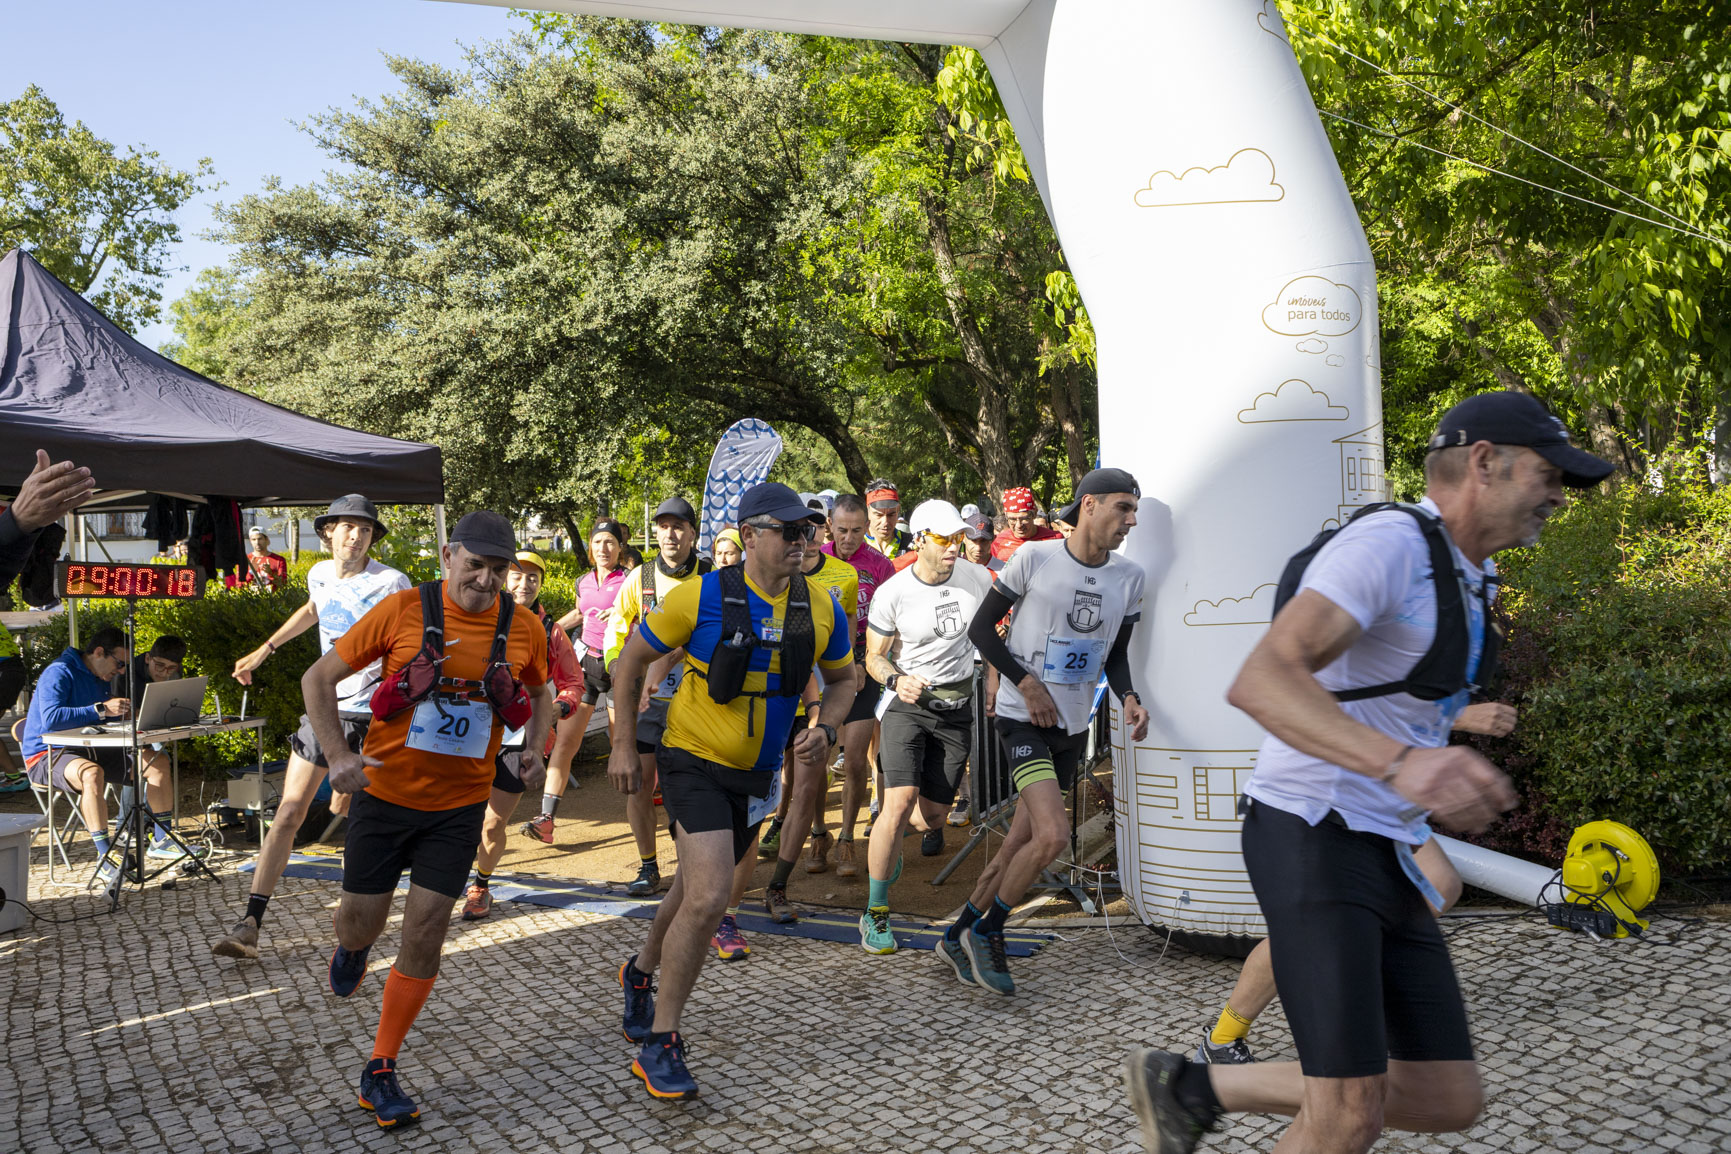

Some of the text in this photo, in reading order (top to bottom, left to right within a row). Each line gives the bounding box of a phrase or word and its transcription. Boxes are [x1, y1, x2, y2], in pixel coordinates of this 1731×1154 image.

[1287, 308, 1351, 323] para todos
[66, 565, 196, 597] 09:00:18
[1064, 652, 1089, 670] 25
[437, 713, 470, 738] 20
